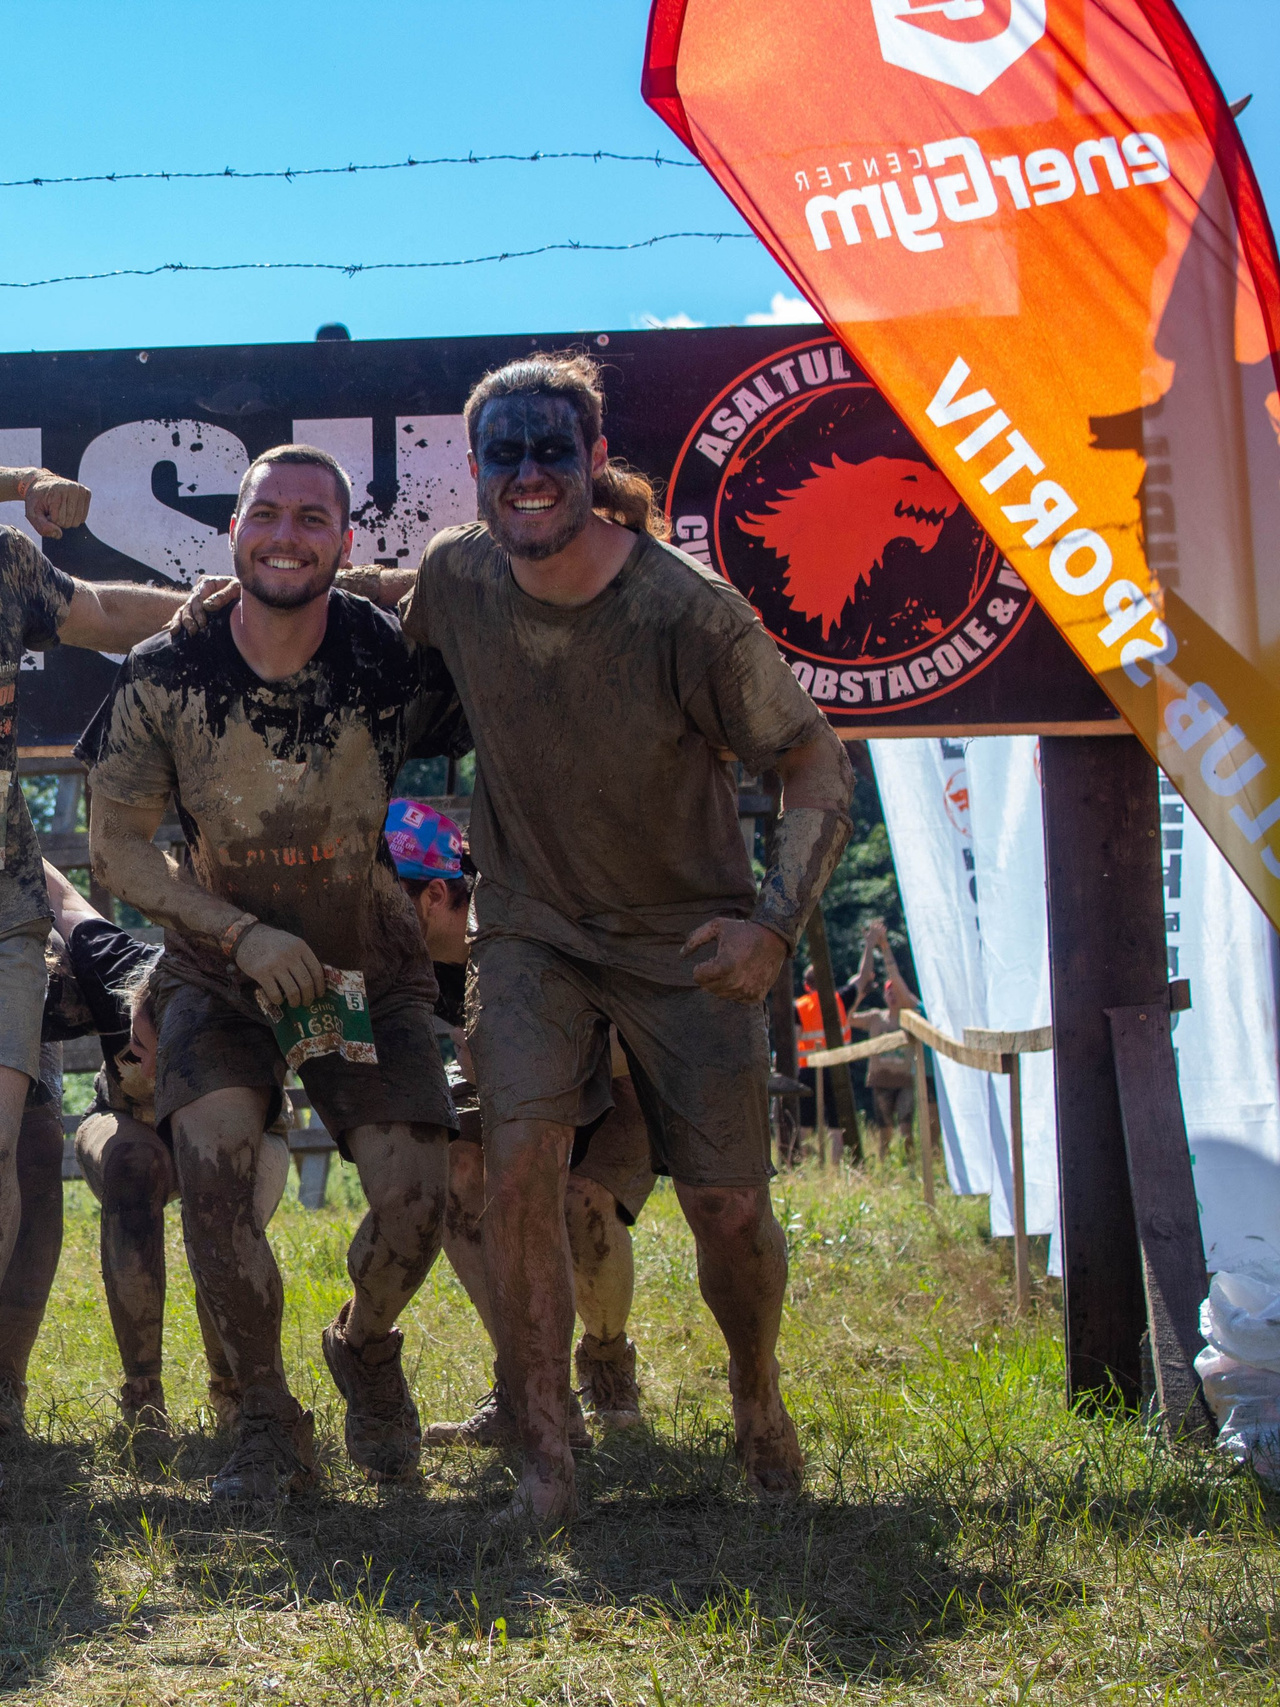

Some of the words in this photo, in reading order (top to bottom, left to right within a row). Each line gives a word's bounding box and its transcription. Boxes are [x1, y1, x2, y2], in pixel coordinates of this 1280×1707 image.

[694, 346, 851, 468] ASALTUL
[792, 621, 997, 703] OBSTACOLE
[986, 596, 1021, 625] &
[350, 997, 360, 1010] 5
